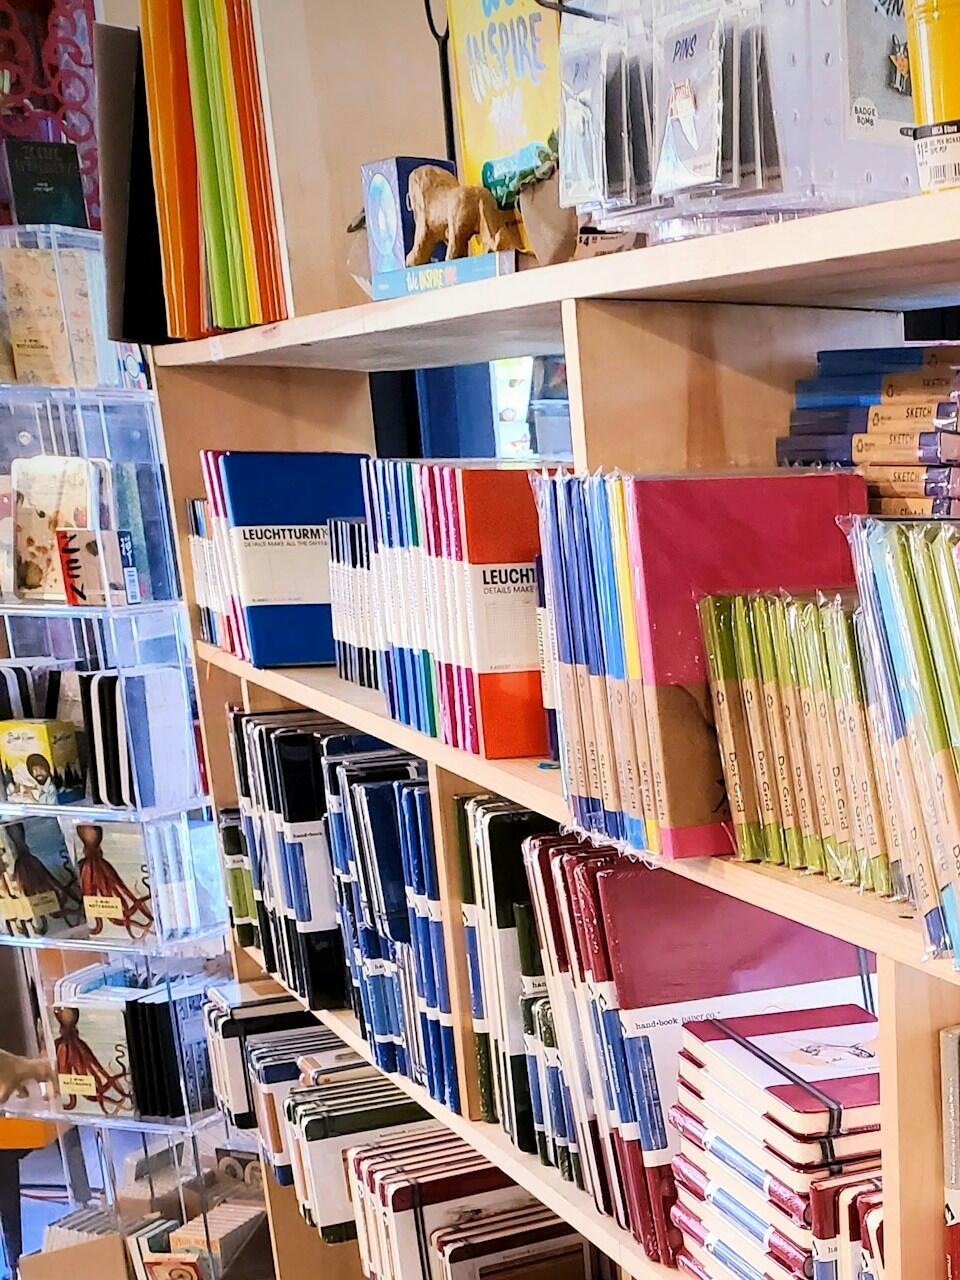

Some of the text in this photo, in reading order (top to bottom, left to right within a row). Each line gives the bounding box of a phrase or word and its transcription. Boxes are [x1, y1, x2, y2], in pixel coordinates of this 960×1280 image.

[466, 12, 545, 104] INSPIRE
[672, 33, 697, 63] PINS
[854, 105, 876, 117] BADGE
[857, 117, 875, 127] BOMB
[419, 269, 444, 290] INSPIRE
[905, 407, 932, 418] SKETCH
[888, 433, 915, 445] SKETCH
[892, 471, 921, 483] SKETCH
[483, 585, 534, 595] DETAILS MAKE
[590, 741, 599, 790] SKETCH
[601, 753, 609, 801] Sketch
[729, 751, 745, 813] Dot Grid
[757, 751, 774, 812] Dot Grid
[642, 761, 652, 812] SKETCH
[778, 755, 794, 818] Dot Grid
[832, 765, 849, 831] Dot Grid
[800, 797, 810, 830] Grid
